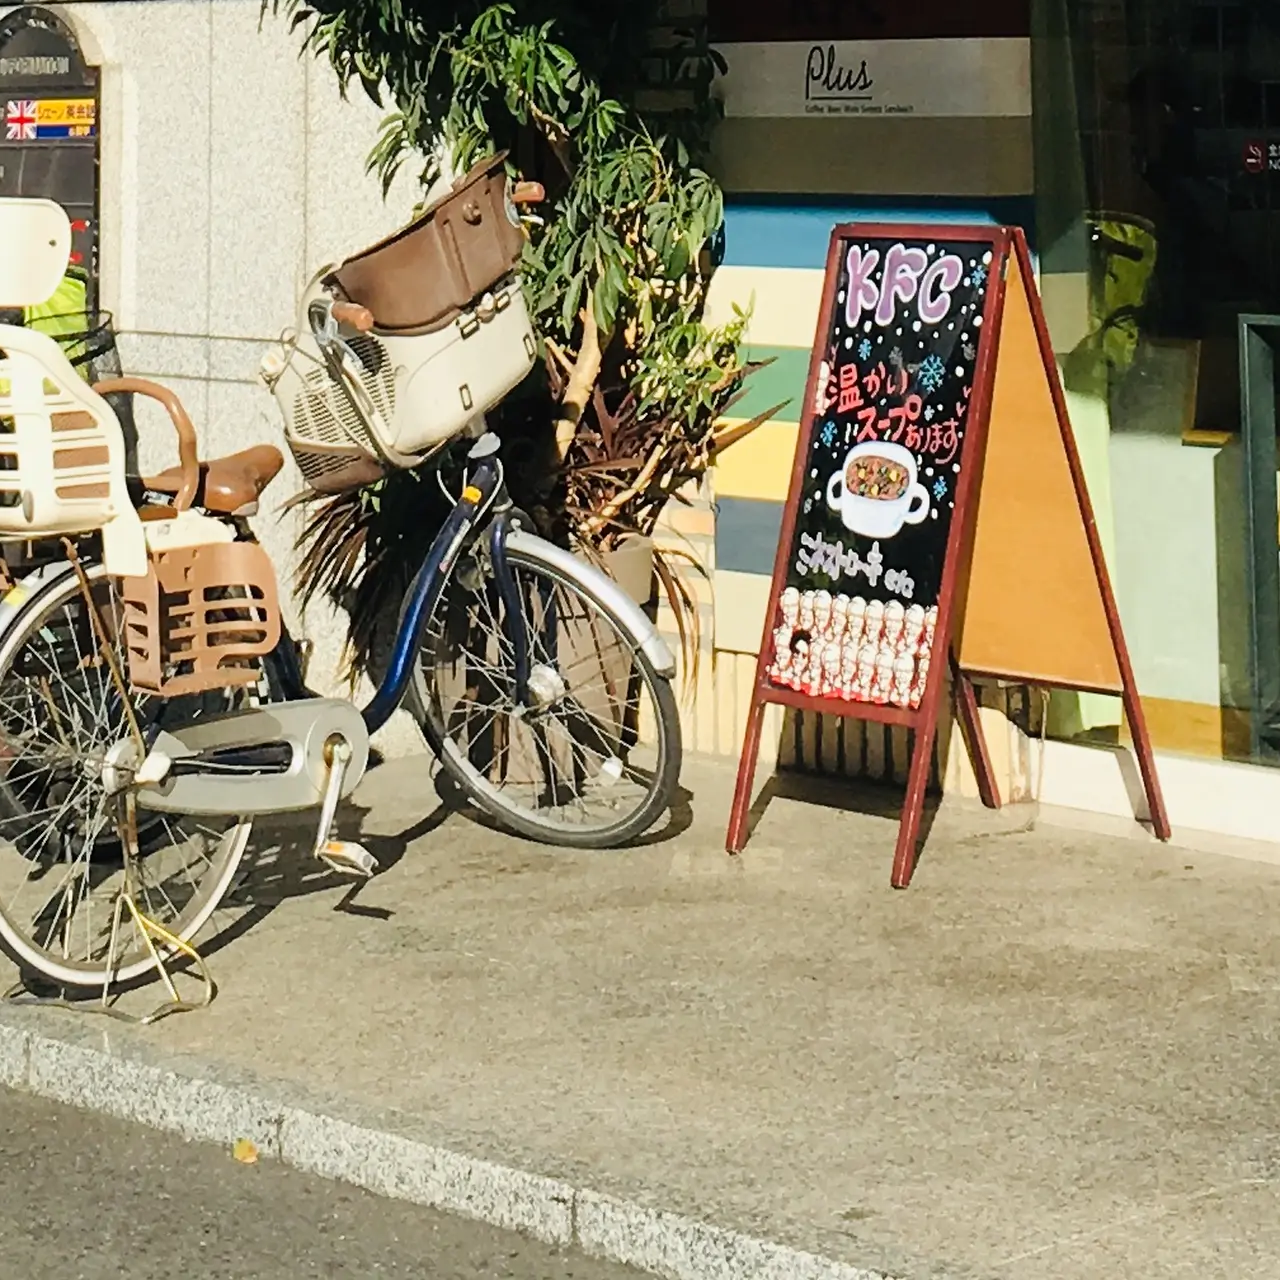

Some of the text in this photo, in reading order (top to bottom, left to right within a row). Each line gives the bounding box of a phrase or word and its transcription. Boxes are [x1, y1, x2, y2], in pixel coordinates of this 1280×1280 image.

[805, 44, 873, 100] Plus
[845, 243, 964, 329] KFC
[826, 361, 910, 414] 温かい
[855, 394, 923, 442] スープ
[904, 417, 960, 463] あります
